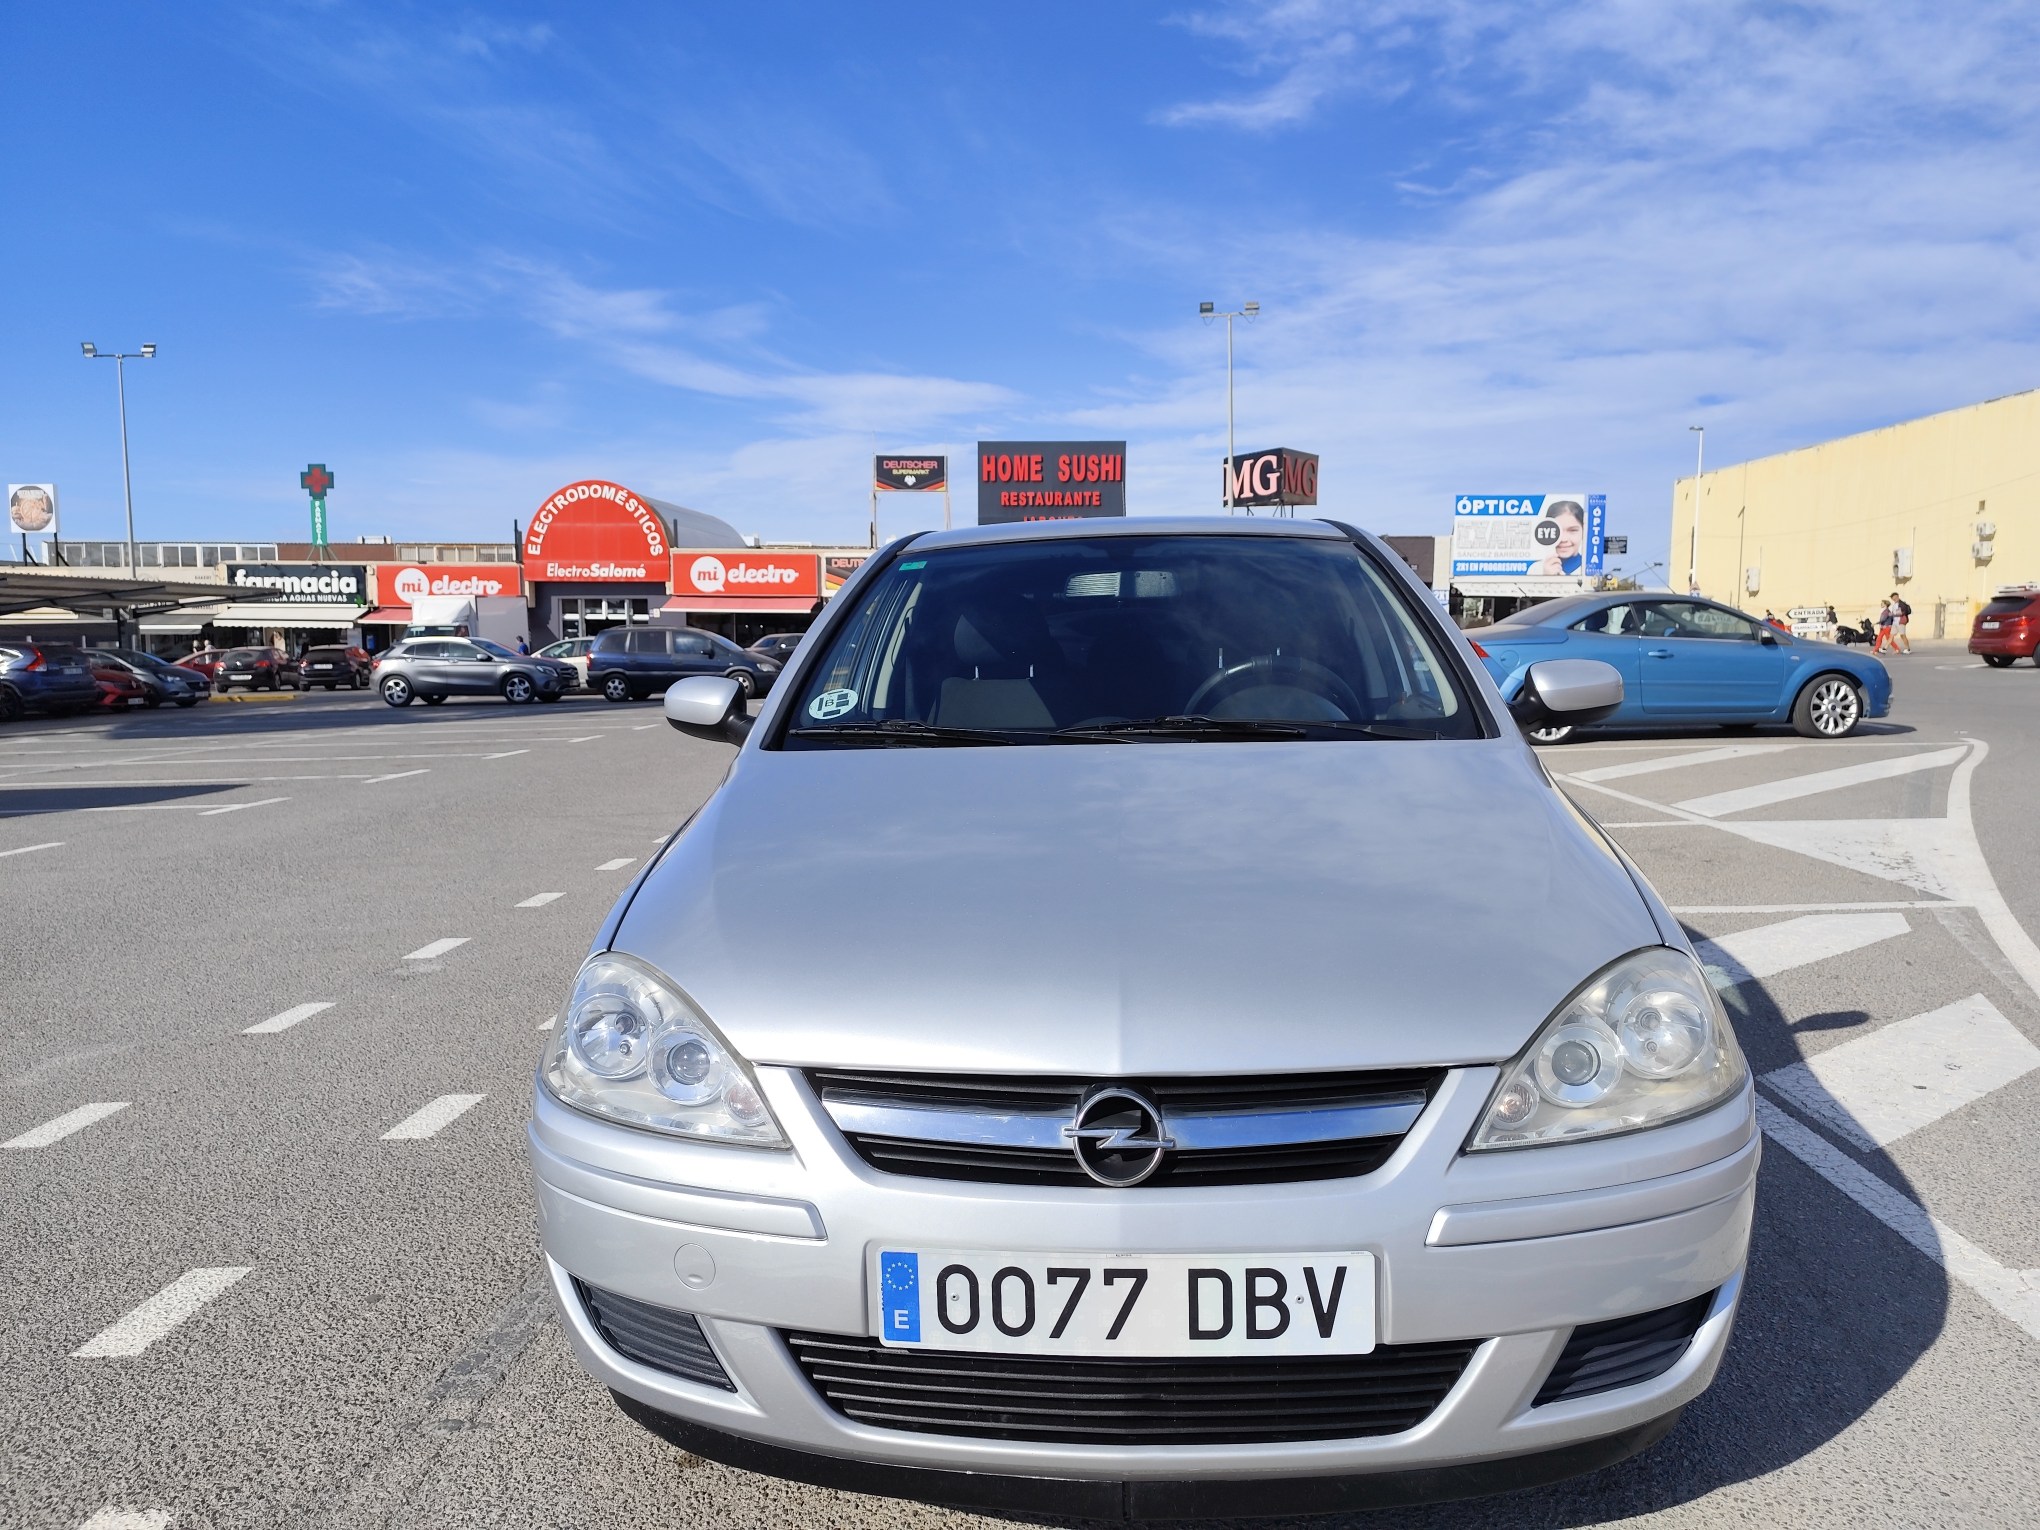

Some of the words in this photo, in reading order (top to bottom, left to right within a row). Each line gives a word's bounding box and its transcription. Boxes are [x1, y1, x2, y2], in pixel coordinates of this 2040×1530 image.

[883, 460, 938, 469] DEUTSCHER
[982, 454, 1042, 482] HOME
[1058, 454, 1122, 482] SUSHI
[1224, 455, 1280, 501] MG
[1284, 455, 1317, 498] MG
[1000, 491, 1101, 507] RESTAURANTE
[1457, 496, 1534, 515] ÓPTICA
[527, 484, 664, 557] ELECTRODOMÉSTICOS
[1537, 527, 1557, 539] EYE
[234, 568, 357, 594] farmacia
[546, 562, 646, 578] ElectroSalomé
[692, 567, 719, 581] mi
[727, 562, 800, 584] electro
[401, 578, 423, 593] mi
[431, 574, 503, 596] electro
[289, 594, 315, 603] AGUAS
[317, 594, 347, 603] NUEVAS
[936, 1263, 1147, 1341] 0077
[1187, 1265, 1346, 1341] DBV
[893, 1309, 909, 1329] E
